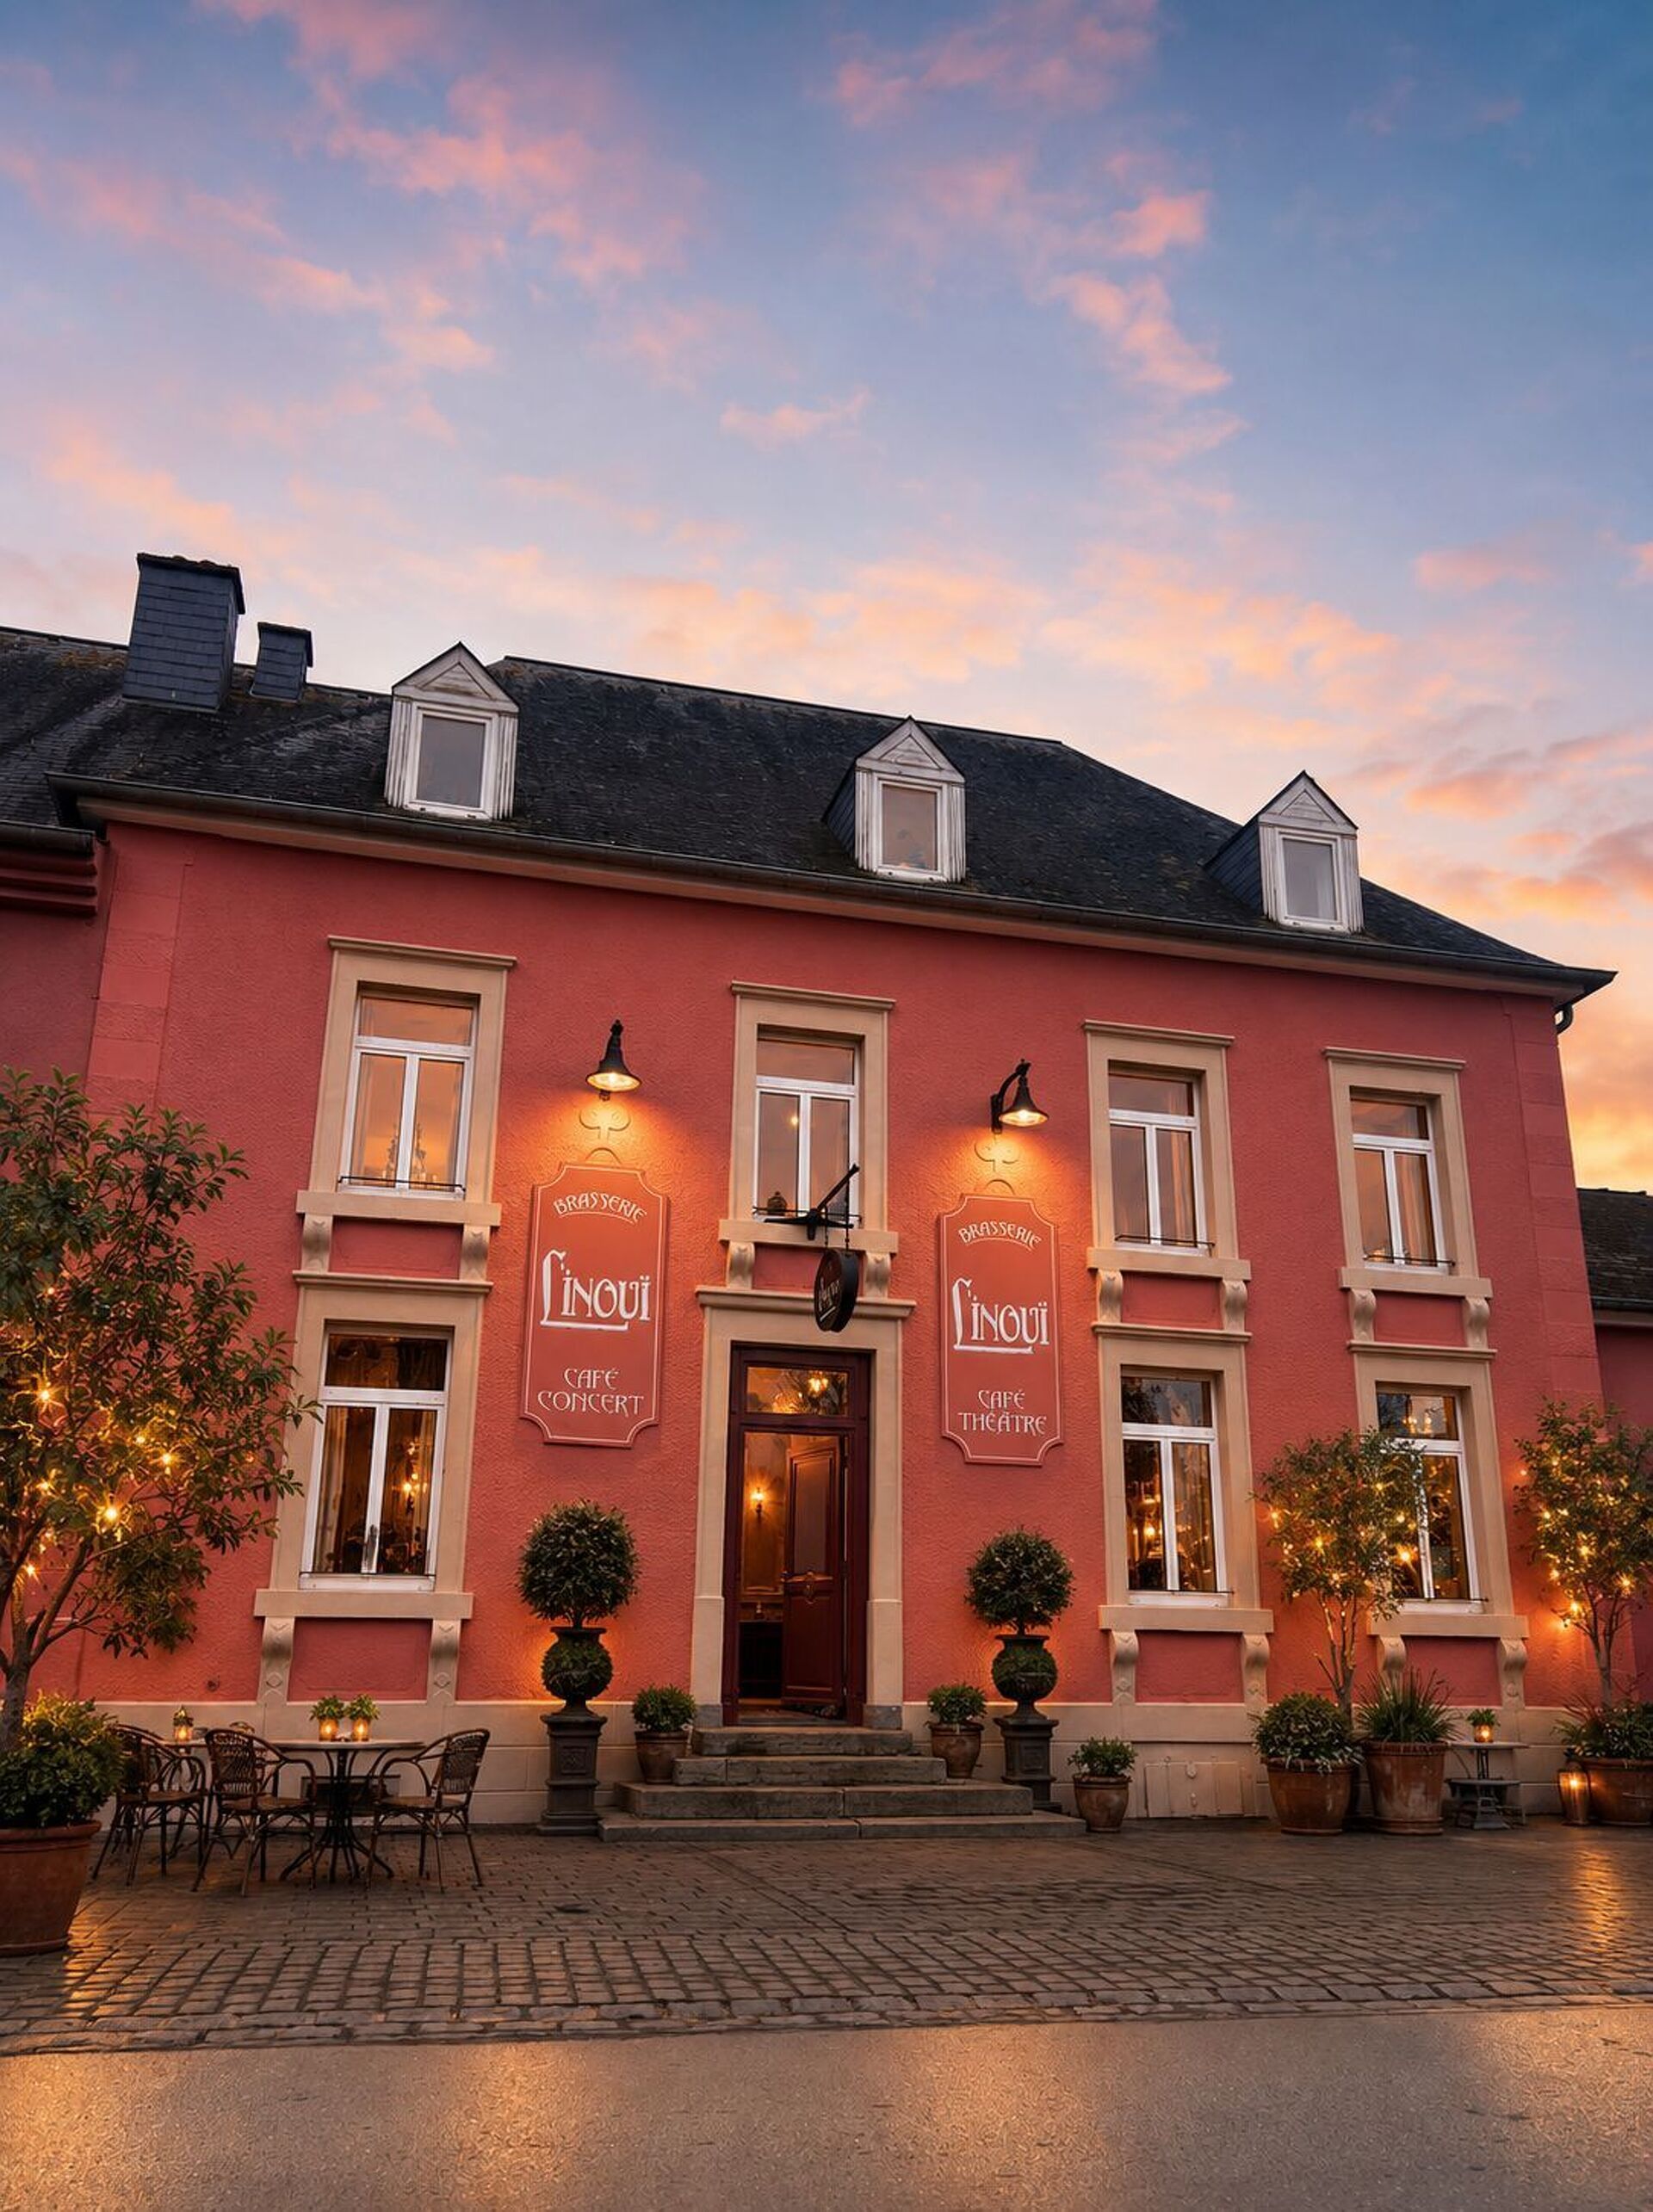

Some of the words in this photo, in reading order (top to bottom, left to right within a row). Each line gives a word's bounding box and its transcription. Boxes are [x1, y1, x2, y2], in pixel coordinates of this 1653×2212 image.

[554, 1191, 647, 1223] BRASSERIE
[958, 1221, 1042, 1251] BRASSERIE
[564, 1367, 619, 1390] CAFÉ
[537, 1390, 645, 1417] CONCERT
[977, 1389, 1025, 1410] CAFÉ
[958, 1410, 1046, 1436] THÉÂTRE
